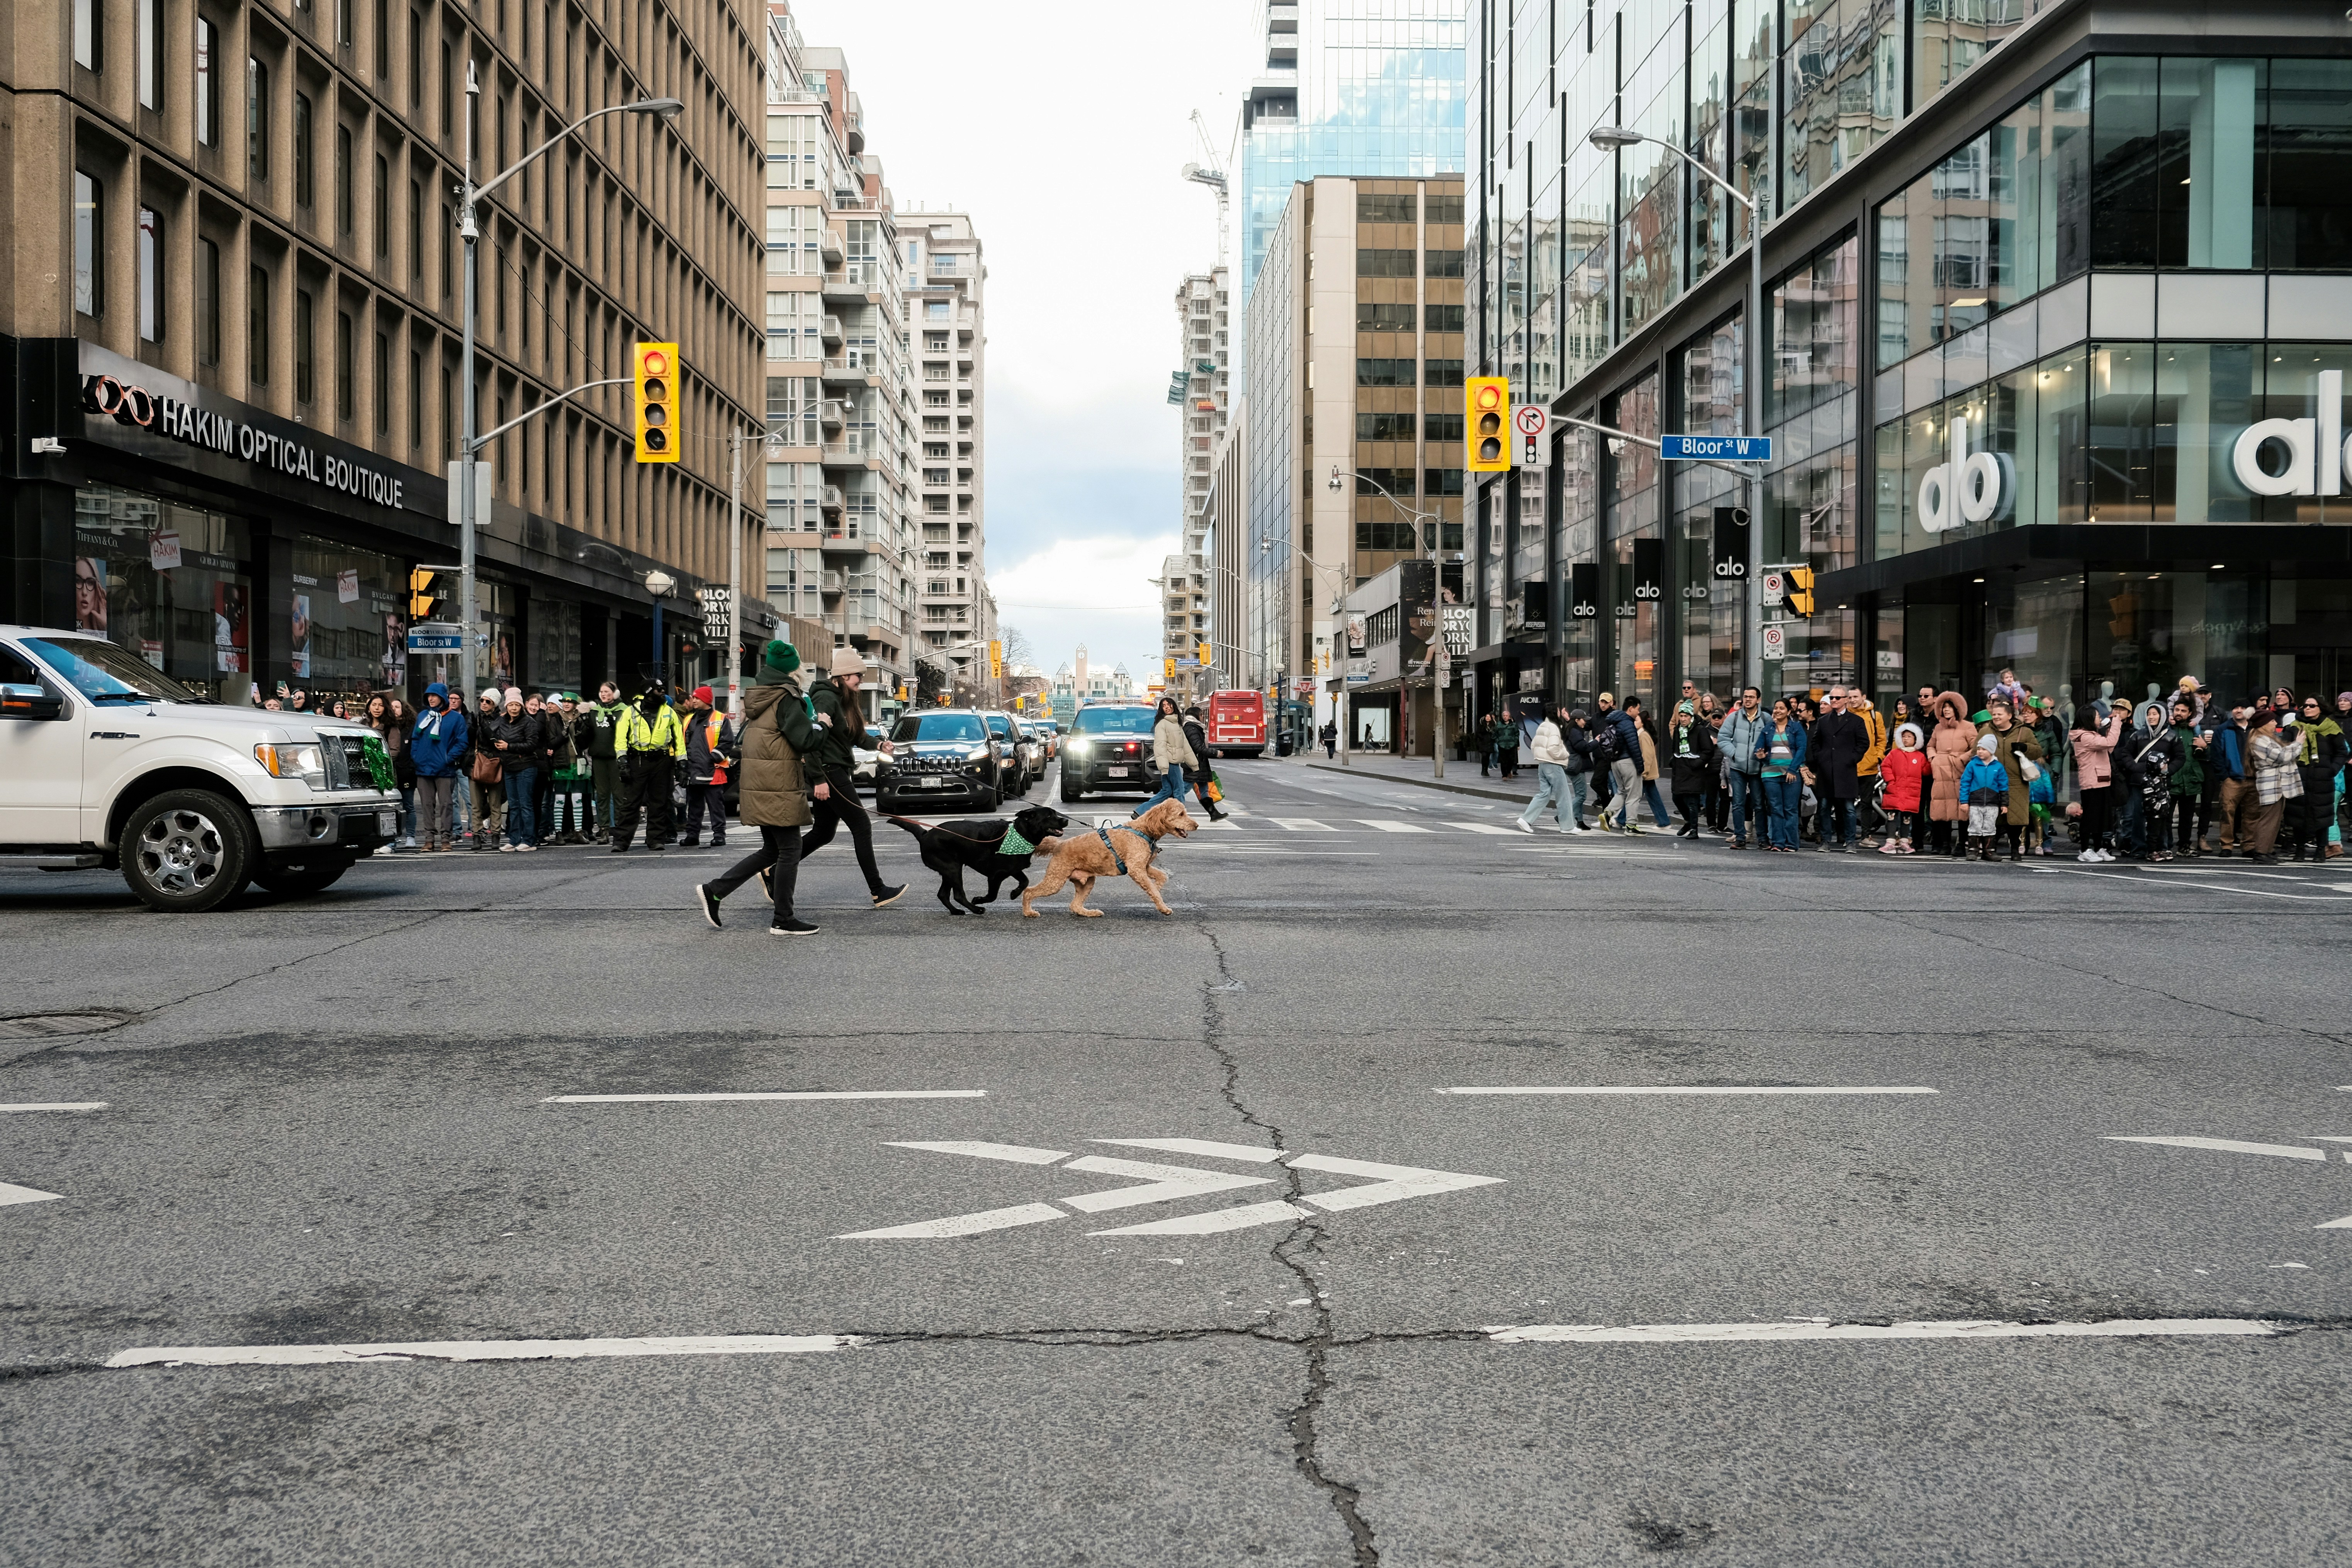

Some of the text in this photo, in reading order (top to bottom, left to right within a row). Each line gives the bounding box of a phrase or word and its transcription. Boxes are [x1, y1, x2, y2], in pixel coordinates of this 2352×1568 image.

[2233, 370, 2352, 495] al
[163, 395, 402, 509] HAKIM OPTICAL BOUTIQUE
[1683, 438, 1749, 455] Bloor St W
[1918, 416, 2000, 532] alo
[154, 544, 178, 558] HAKIM
[1716, 556, 1744, 576] alo
[293, 574, 318, 586] BURBERRY
[340, 582, 356, 594] HAKIM
[1635, 581, 1660, 598] alo
[372, 591, 396, 601] BVLGARI
[1573, 601, 1595, 615] alo
[418, 638, 436, 646] Bloor
[445, 638, 452, 646] W
